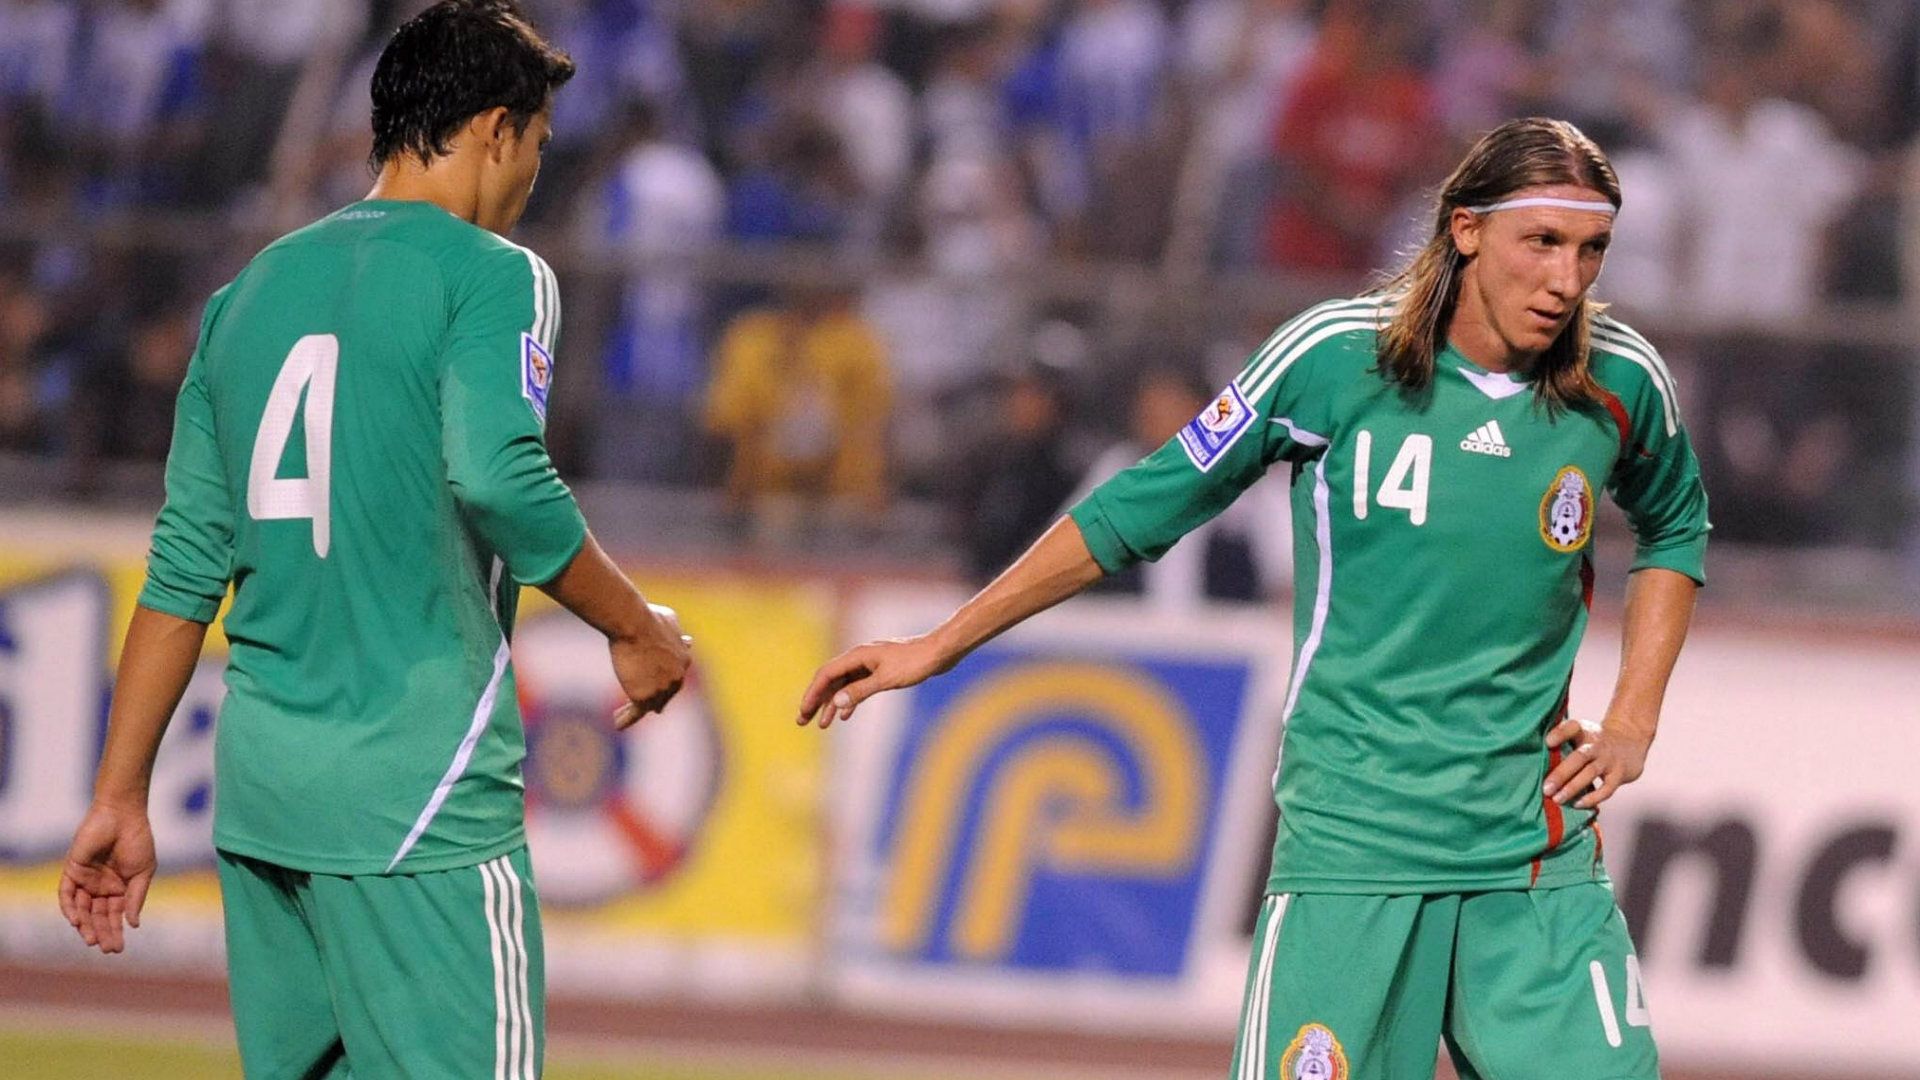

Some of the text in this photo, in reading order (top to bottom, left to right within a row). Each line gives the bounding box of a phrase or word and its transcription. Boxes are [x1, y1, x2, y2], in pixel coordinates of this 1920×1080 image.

[247, 333, 339, 559] 4
[1353, 429, 1433, 526] 14
[1460, 437, 1511, 458] adidas
[1589, 953, 1650, 1048] 14
